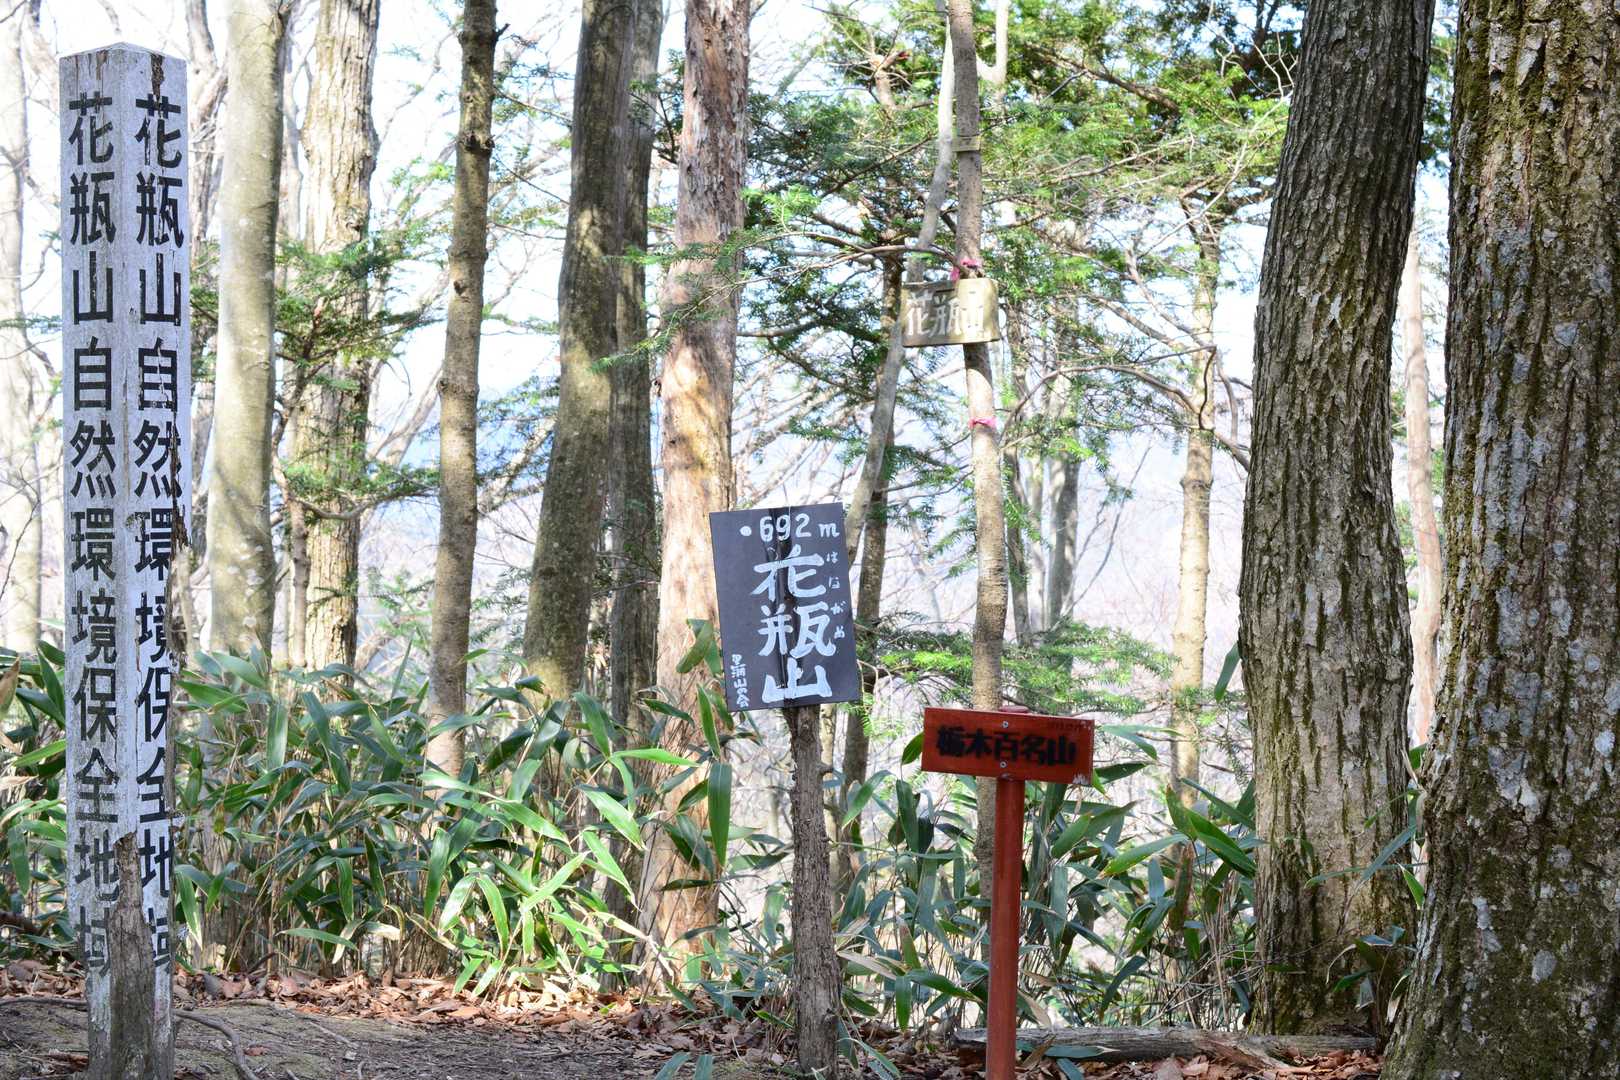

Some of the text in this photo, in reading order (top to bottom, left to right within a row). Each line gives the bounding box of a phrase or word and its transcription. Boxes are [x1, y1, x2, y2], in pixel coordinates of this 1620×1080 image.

[68, 91, 120, 977] 花瓶山自然環境保全地域
[751, 543, 837, 704] 花瓶山
[936, 725, 1077, 766] 栃木百名山
